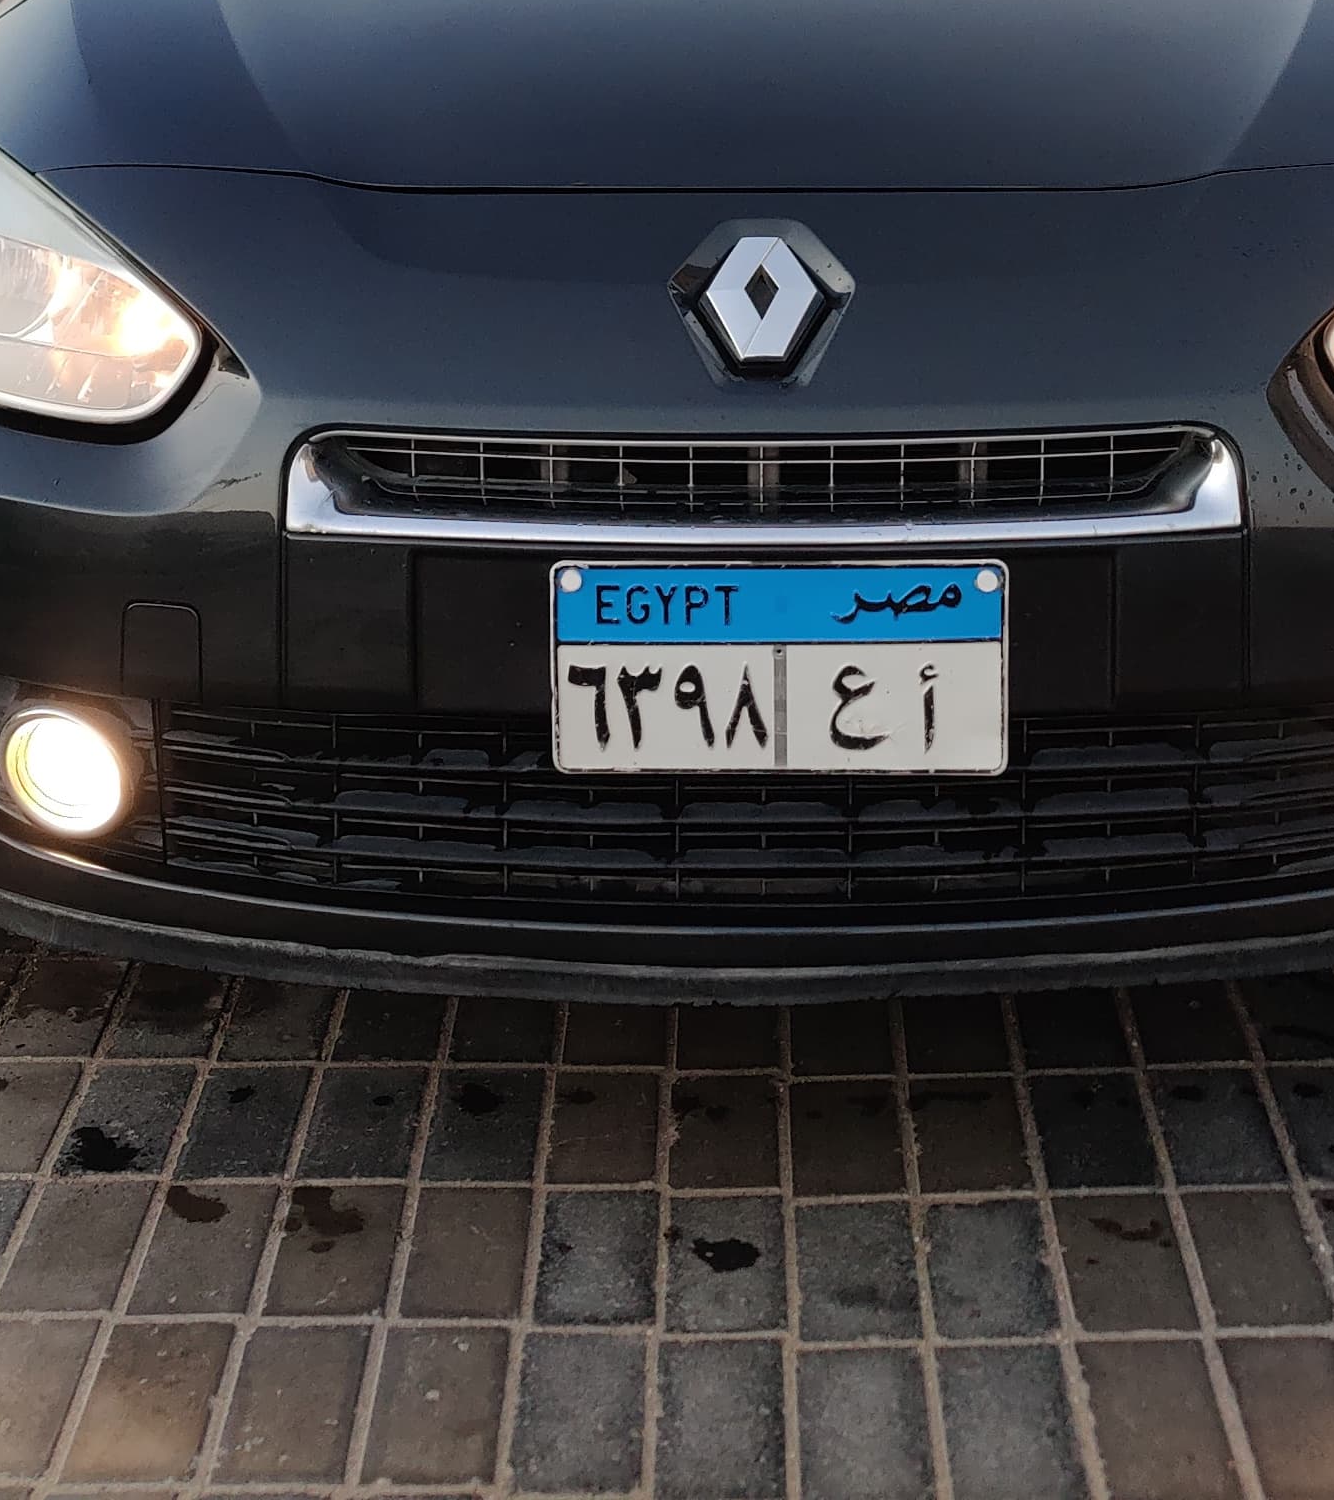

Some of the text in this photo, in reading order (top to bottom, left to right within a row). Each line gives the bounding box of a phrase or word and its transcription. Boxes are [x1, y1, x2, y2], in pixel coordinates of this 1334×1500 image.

[595, 584, 740, 627] EGYPT
[830, 582, 963, 625] مصر
[566, 662, 769, 752] ٦٣٩٨
